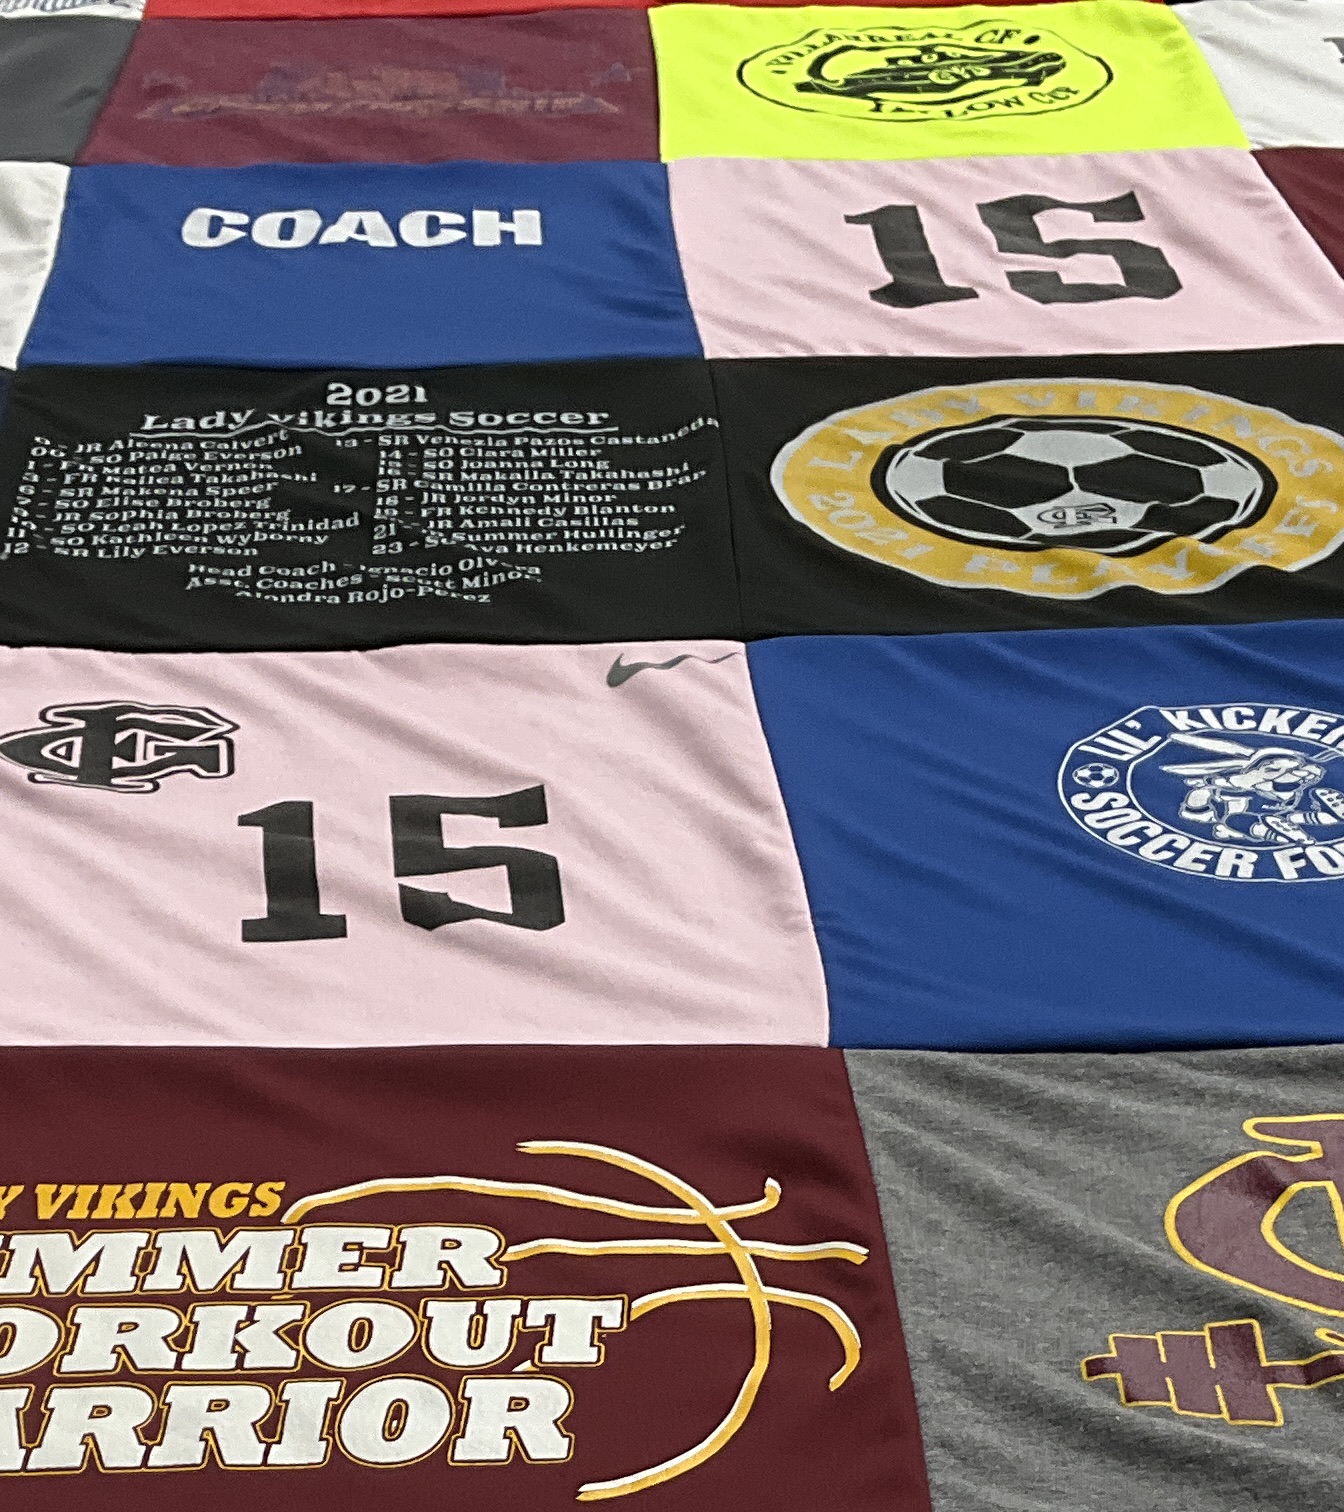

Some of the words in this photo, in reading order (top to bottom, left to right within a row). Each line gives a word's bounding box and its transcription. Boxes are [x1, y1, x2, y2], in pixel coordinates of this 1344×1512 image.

[181, 207, 544, 250] COACH
[844, 190, 1184, 309] 15
[326, 382, 429, 406] 2021
[139, 408, 256, 432] Lady
[449, 410, 611, 428] Soccer
[200, 429, 288, 450] Calvert
[378, 434, 409, 447] SR
[590, 417, 720, 445] Castaneda
[90, 453, 122, 464] SO
[204, 445, 302, 461] Everson
[380, 449, 402, 460] 14
[423, 447, 454, 459] SO
[459, 447, 525, 458] Clara
[530, 447, 602, 458] Miller
[422, 471, 454, 481] SR
[559, 461, 690, 481] Takahashi
[423, 459, 454, 470] SO
[460, 459, 544, 470] Joanna
[550, 458, 611, 470] Long
[59, 487, 94, 498] SR
[205, 482, 279, 498] Speer
[376, 478, 408, 493] SR
[512, 481, 641, 493] Contreras
[54, 499, 90, 510] SO
[421, 491, 447, 505] JR
[453, 492, 536, 506] Jordyn
[543, 492, 617, 504] Minor
[51, 512, 81, 522] JR
[88, 509, 179, 522] Sophia
[459, 504, 567, 518] Kennedy
[574, 504, 676, 516] Blanton
[60, 522, 96, 535] SO
[102, 521, 163, 533] Leah
[171, 521, 247, 535] Lopez
[252, 511, 360, 532] Trinidad
[460, 516, 531, 529] Amali
[537, 516, 639, 528] Casillas
[50, 536, 85, 547] SO
[91, 531, 208, 546] Kathleen
[373, 523, 397, 540] 21
[452, 531, 558, 543] Summer
[563, 524, 686, 541] Hullinger
[53, 546, 90, 558] SR
[97, 545, 146, 559] Lily
[152, 544, 259, 557] Everson
[372, 541, 403, 555] 23
[515, 538, 678, 553] Henkemeyer
[188, 563, 252, 577] Head
[258, 560, 337, 577] Coach
[255, 573, 363, 590] Coaches
[1078, 720, 1162, 762] LIL'
[1070, 791, 1258, 878] SOCCER
[238, 784, 566, 943] 15
[35, 1180, 287, 1220] VIKINGS
